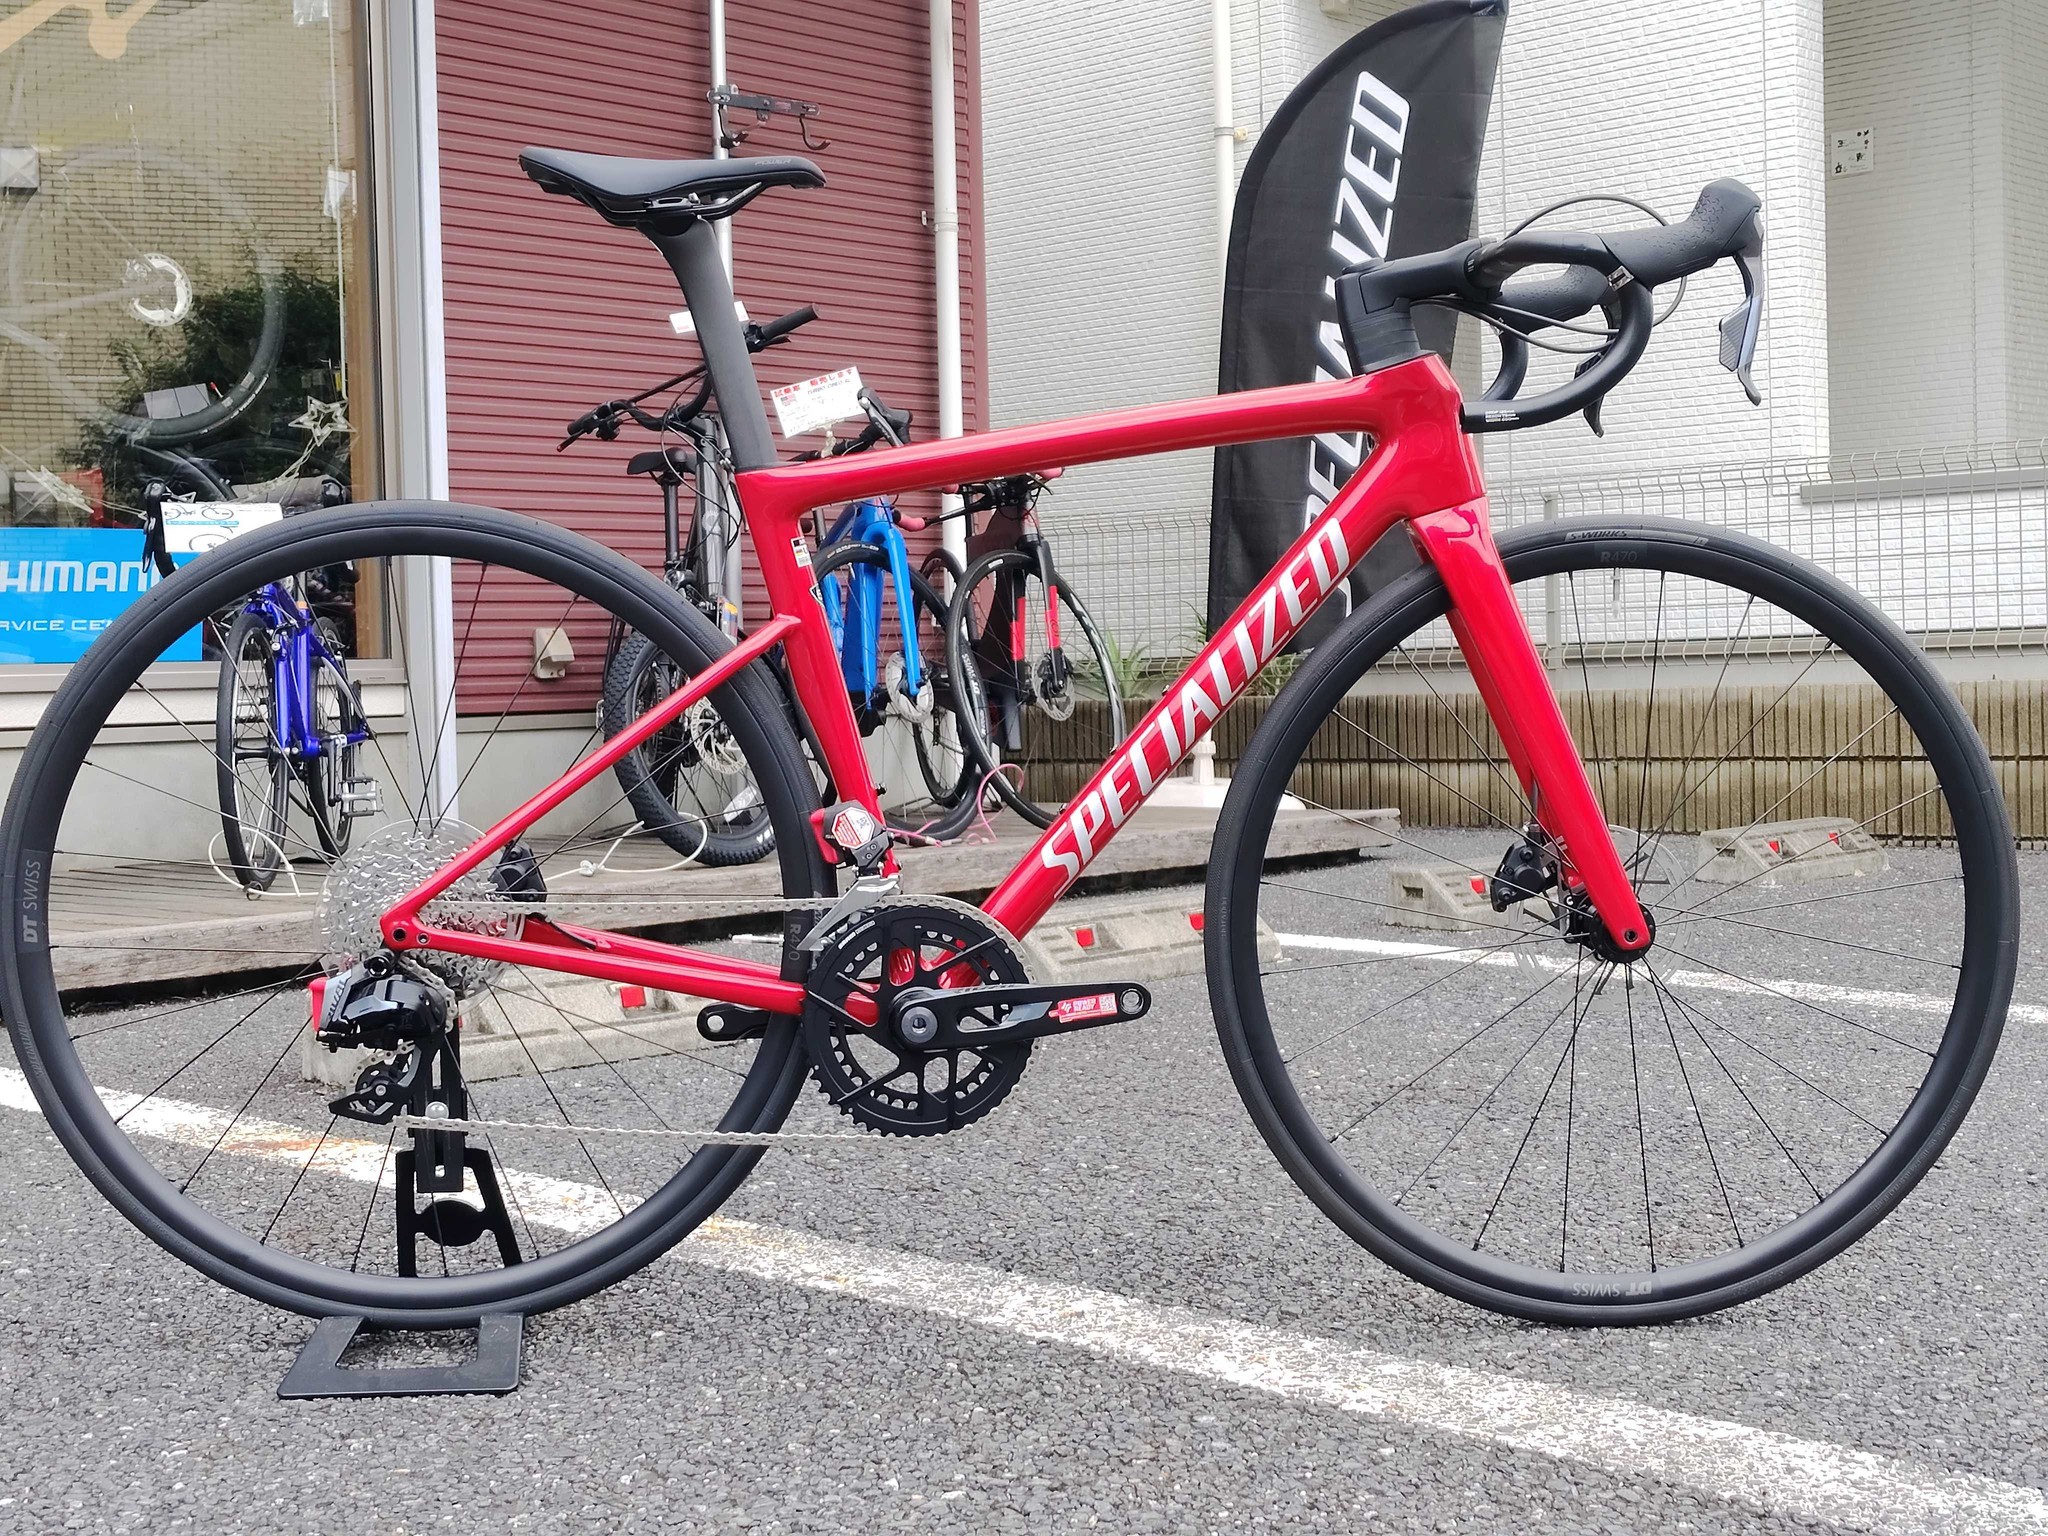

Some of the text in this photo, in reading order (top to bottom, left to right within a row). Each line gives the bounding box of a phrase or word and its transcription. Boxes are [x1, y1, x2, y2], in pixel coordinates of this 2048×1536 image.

[1303, 71, 1411, 616] ECAIZED
[1570, 530, 1627, 539] S-WORKS
[1601, 551, 1637, 562] R470
[1041, 517, 1351, 878] SPECIALIZED
[23, 859, 41, 943] DT SWISS
[1572, 1281, 1652, 1297] DT SWISS
